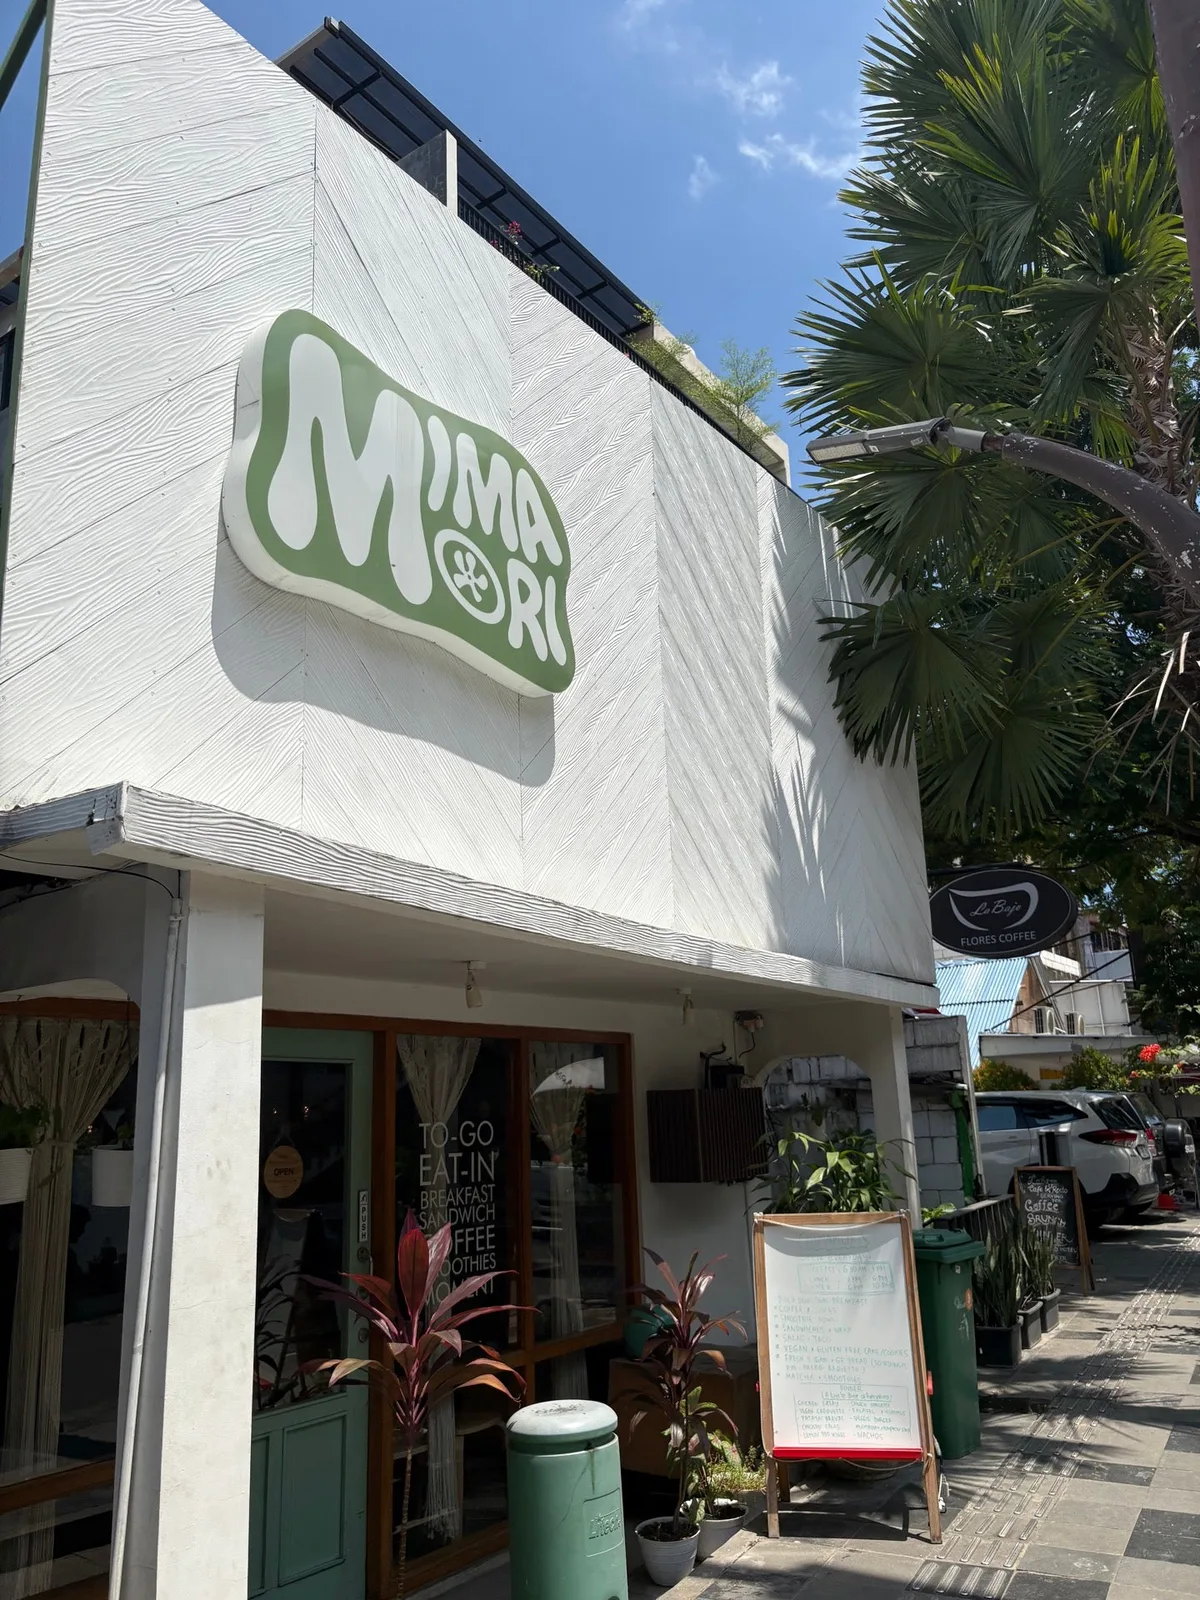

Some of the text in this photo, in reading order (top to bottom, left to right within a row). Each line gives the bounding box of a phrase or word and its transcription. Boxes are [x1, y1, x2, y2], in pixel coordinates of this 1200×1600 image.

[961, 930, 1037, 946] FLORES COFFEE
[419, 1120, 494, 1149] TO-GO
[273, 1167, 295, 1176] OPEN
[419, 1150, 496, 1186] EAT-IN
[420, 1184, 496, 1209] BREAKFAST
[419, 1204, 496, 1231] SANDWICH
